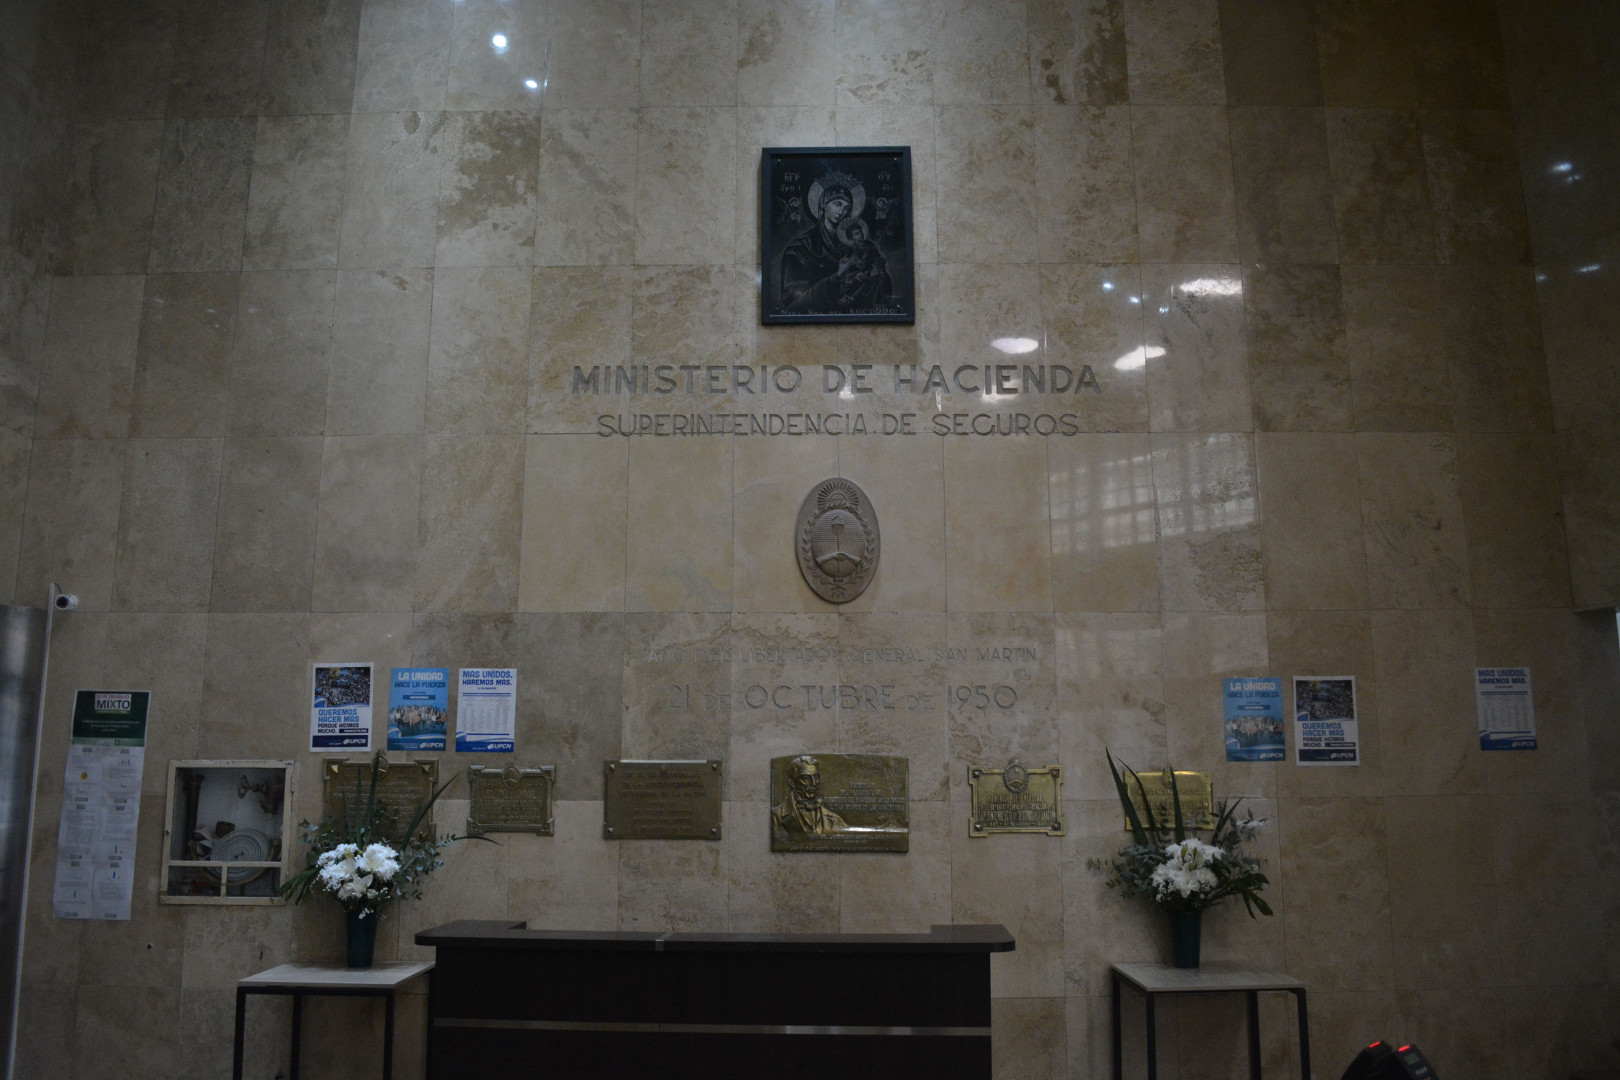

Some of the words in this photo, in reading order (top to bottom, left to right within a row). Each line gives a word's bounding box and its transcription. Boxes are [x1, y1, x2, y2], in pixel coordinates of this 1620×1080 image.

[571, 365, 803, 395] MINISTERIO
[822, 365, 873, 394] DE
[893, 365, 1102, 395] HACIENDA
[881, 413, 917, 436] DE
[931, 413, 1080, 437] SEGUROS
[739, 646, 841, 664] LIBERTADOR
[849, 647, 925, 663] GENERAL
[934, 647, 968, 662] SAN
[976, 647, 1037, 663] MARTIN
[398, 672, 410, 680] LA
[411, 672, 443, 680] UNIDAD
[1230, 682, 1241, 690] LA
[1243, 682, 1275, 690] UNIDAD
[666, 684, 690, 711] 21
[703, 694, 732, 711] DE
[744, 684, 896, 711] OCTUBRE
[906, 694, 935, 711] DE
[946, 685, 1018, 711] 1950
[96, 700, 130, 709] MIXTO
[318, 708, 358, 716] QUEREMOS
